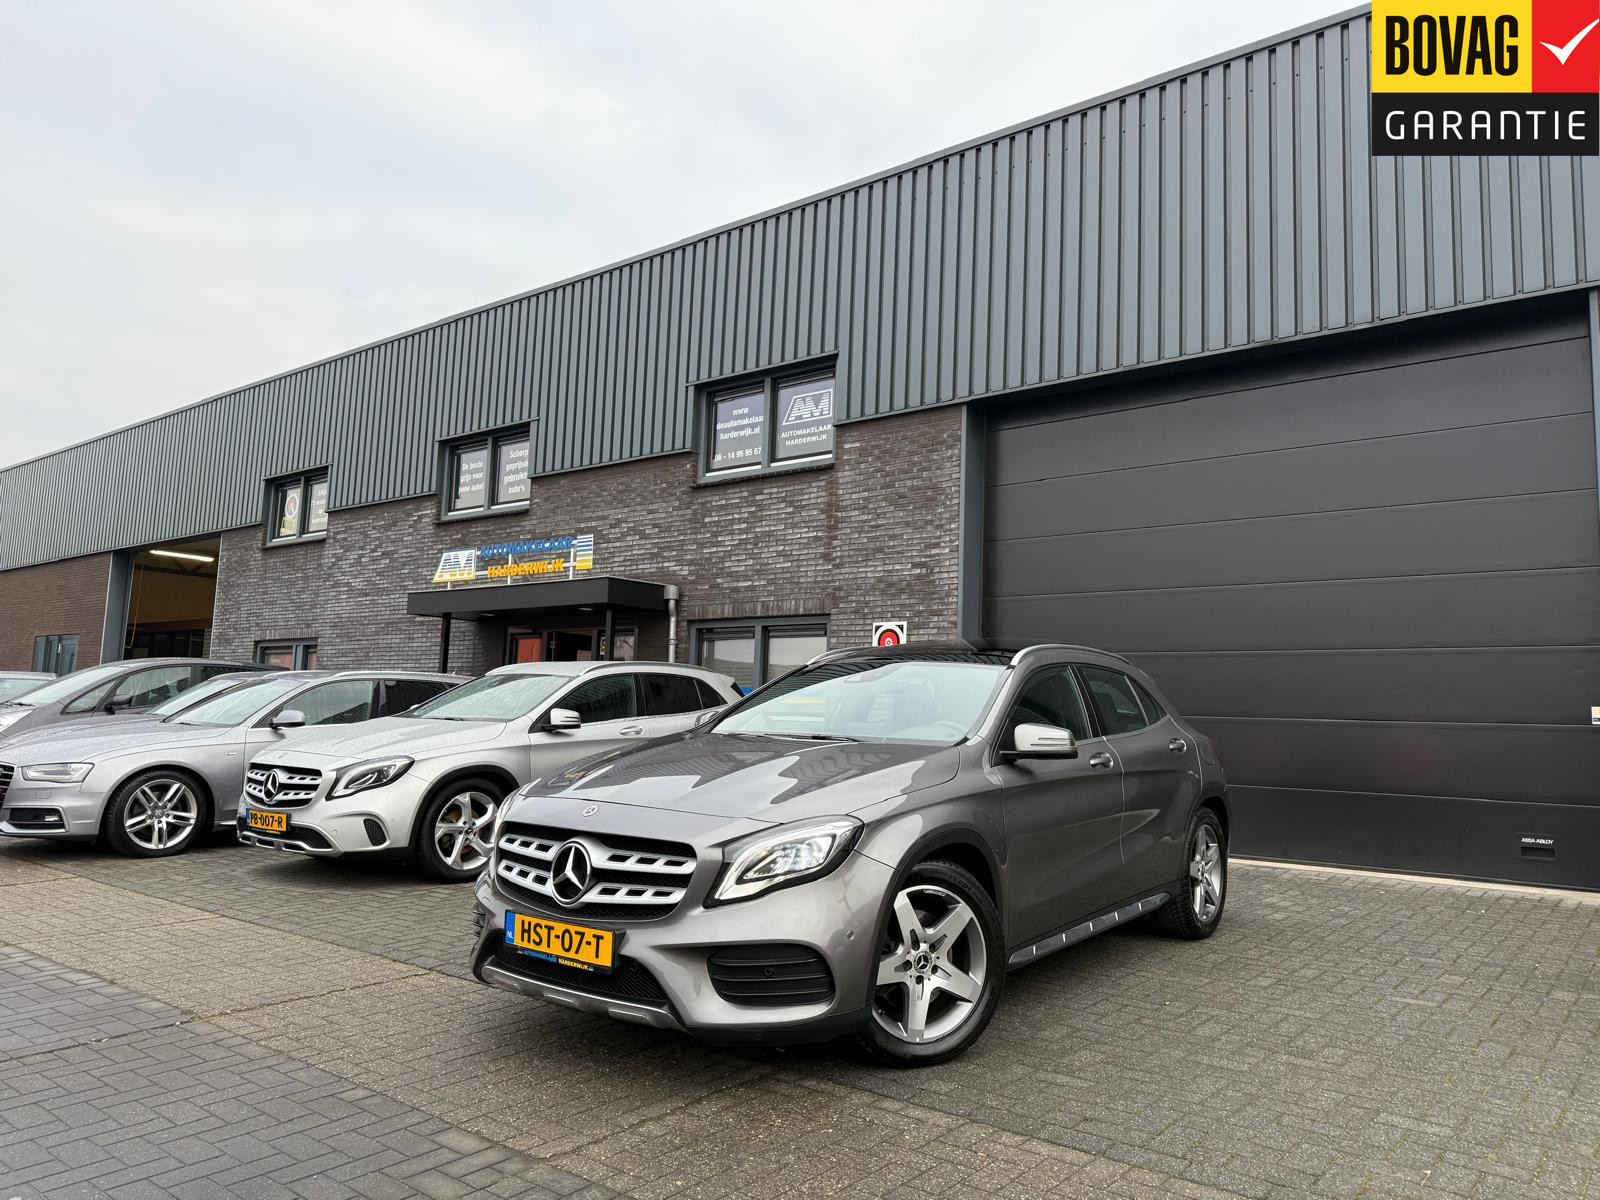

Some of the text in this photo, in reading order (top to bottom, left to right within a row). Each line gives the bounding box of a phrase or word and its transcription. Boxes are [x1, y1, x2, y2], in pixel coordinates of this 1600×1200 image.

[733, 407, 749, 416] www
[720, 426, 760, 441] harderwijk.nl
[781, 424, 833, 438] AUTOMAKELAAR
[786, 433, 827, 446] HARDERWIJK
[728, 451, 735, 460] 14
[745, 448, 753, 457] 95
[754, 447, 762, 456] 67
[463, 460, 483, 471] De beste
[473, 471, 484, 479] voor
[479, 535, 573, 558] AUTOMAKELAAR
[487, 558, 565, 578] HARDERWIJK
[507, 930, 514, 939] NL
[521, 920, 604, 959] HST-07-T
